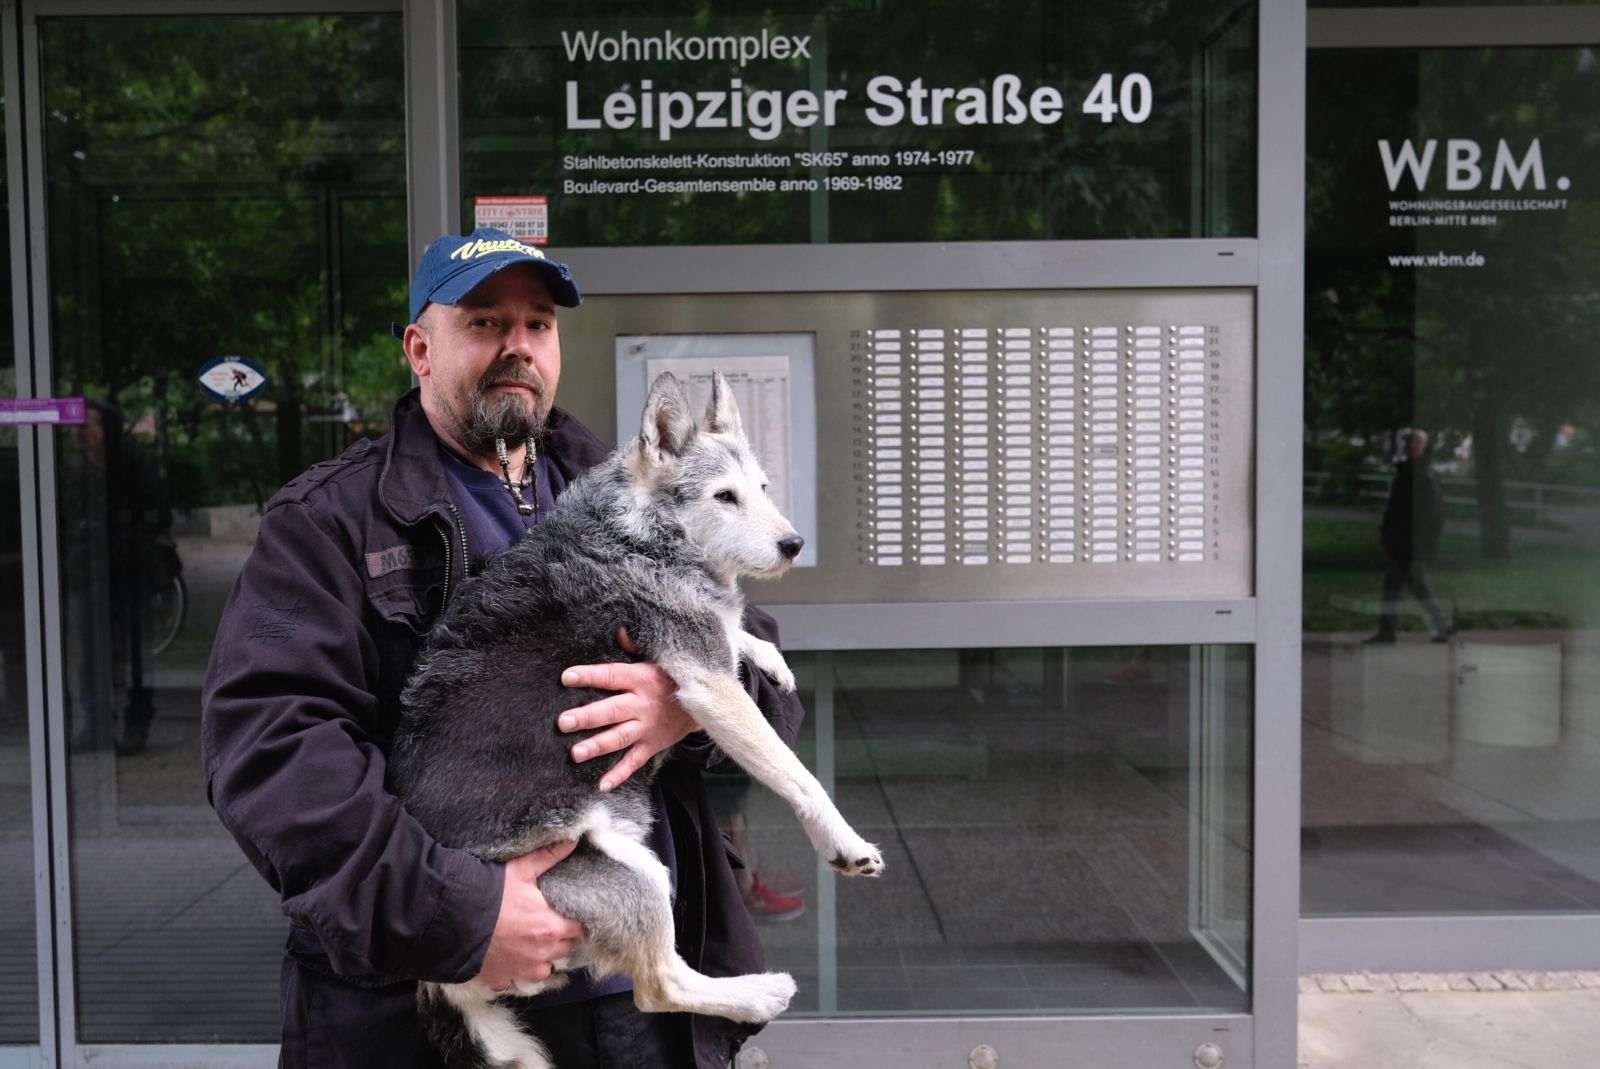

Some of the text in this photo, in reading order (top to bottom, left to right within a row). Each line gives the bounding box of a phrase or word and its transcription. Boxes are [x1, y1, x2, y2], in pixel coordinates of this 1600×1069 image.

[561, 28, 812, 66] Wohnkomplex
[566, 72, 1153, 140] Leipziger Straße 40
[563, 149, 975, 170] Stahlbetonskelett-Konstruktion "SK65" anno 1974-1977
[1377, 137, 1571, 192] WBM.
[563, 175, 903, 194] Boulevard-Gesamtensemble anno 1969-1982
[1388, 198, 1568, 211] WOHNUNGSBAUGESELLSCHAFT
[1389, 214, 1498, 227] BERLIN-MITTE MBH
[1388, 250, 1486, 267] www.wbm.de
